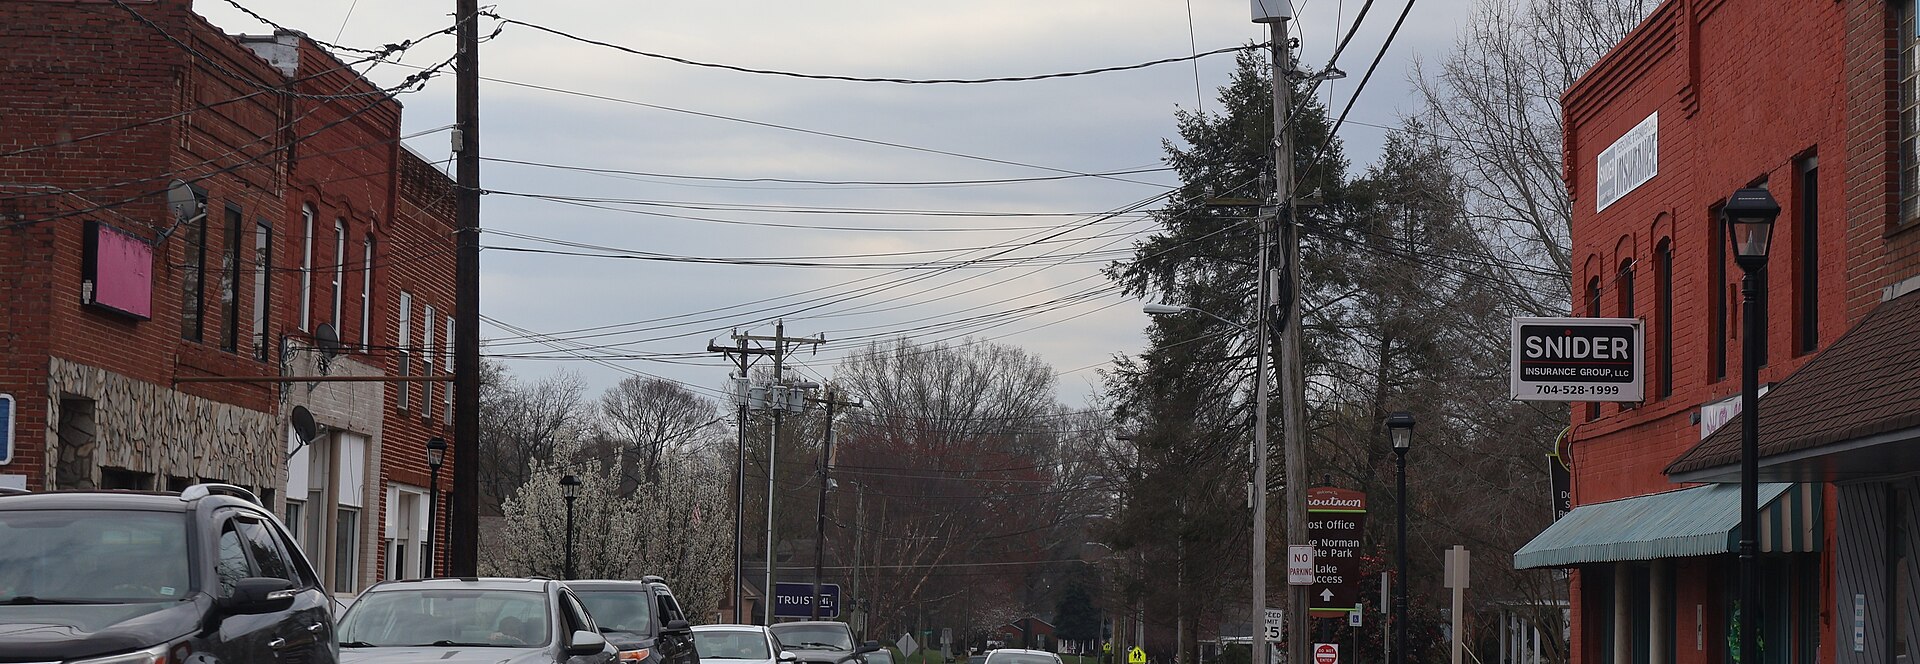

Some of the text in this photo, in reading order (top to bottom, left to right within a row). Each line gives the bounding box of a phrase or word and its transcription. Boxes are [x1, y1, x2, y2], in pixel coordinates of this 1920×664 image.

[1525, 329, 1629, 360] SNIDER
[1525, 367, 1577, 376] INSURANCE
[1580, 368, 1614, 378] GROUP,
[1536, 385, 1619, 395] 704-528-1999
[1308, 495, 1361, 508] routman
[1308, 520, 1355, 530] ost Office
[1308, 538, 1360, 548] ke Norman
[1294, 553, 1308, 563] NO
[1313, 549, 1353, 558] ate Park
[1290, 567, 1313, 576] PARKING
[1315, 564, 1338, 574] Lake
